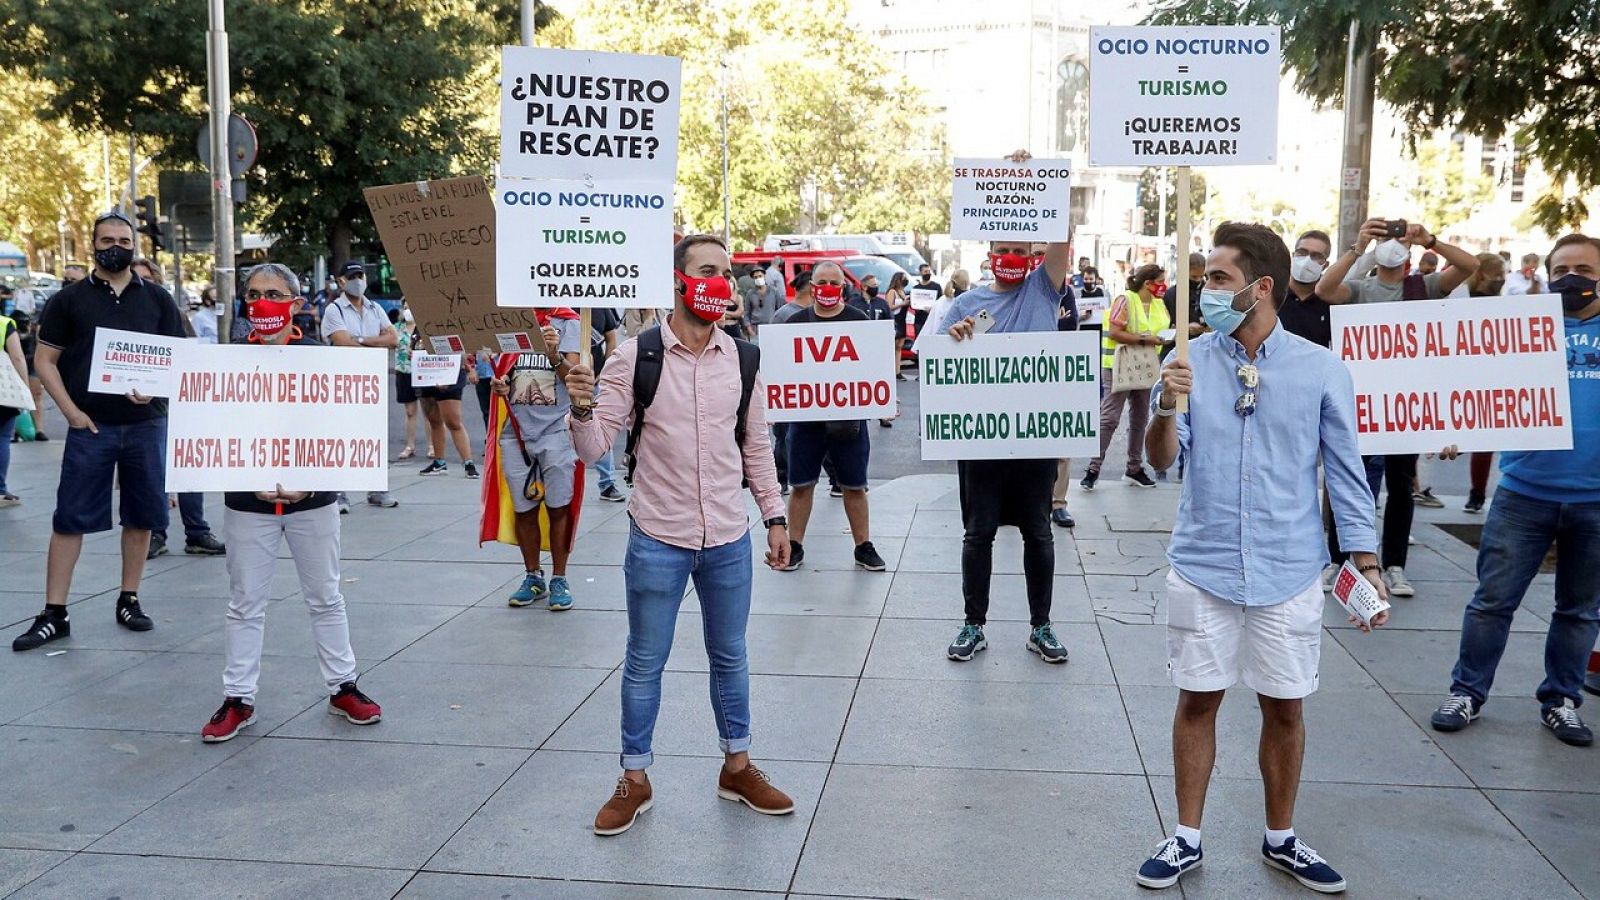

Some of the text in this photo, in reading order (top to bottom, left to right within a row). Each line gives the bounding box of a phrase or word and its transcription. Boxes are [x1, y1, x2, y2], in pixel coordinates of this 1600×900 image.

[1098, 38, 1270, 55] OCIO NOCTURNO
[1178, 65, 1189, 73] =
[511, 73, 670, 104] ¿NUESTRO
[1138, 80, 1227, 96] TURISMO
[526, 102, 654, 131] PLAN DE
[1124, 117, 1241, 136] ¡QUEREMOS
[519, 131, 660, 160] RESCATE?
[1132, 139, 1237, 155] TRABAJAR!
[954, 168, 1070, 179] SE TRASPASA OCIO
[975, 181, 1047, 192] NOCTURNO
[503, 191, 665, 209] OCIO NOCTURNO
[985, 192, 1035, 205] RAZÓN:
[580, 216, 591, 224] =
[962, 207, 1057, 219] PRINCIPADO DE
[979, 221, 1039, 232] ASTURIAS
[406, 224, 493, 254] CONGRESO
[542, 229, 627, 245] TURISMO
[419, 259, 477, 282] FUERA
[530, 263, 640, 281] ¡QUEREMOS
[537, 283, 637, 299] TRABAJAR!
[695, 282, 707, 294] #
[438, 287, 470, 313] YA
[1341, 316, 1557, 361] AYUDAS AL ALQUILER
[107, 341, 172, 357] #SALVEMOS
[793, 335, 860, 364] IVA
[925, 350, 1060, 386] FLEXIBILIZACIÓN
[1065, 355, 1094, 382] DEL
[178, 365, 380, 404] AMPLIACIÓN DE LOS ERTES
[766, 380, 891, 410] REDUCIDO
[1384, 391, 1445, 432] LOCAL
[1450, 387, 1563, 430] COMERCIAL
[926, 411, 1096, 441] MERCADO LABORAL
[174, 438, 381, 468] HASTA EL 15 DE MARZO 2021
